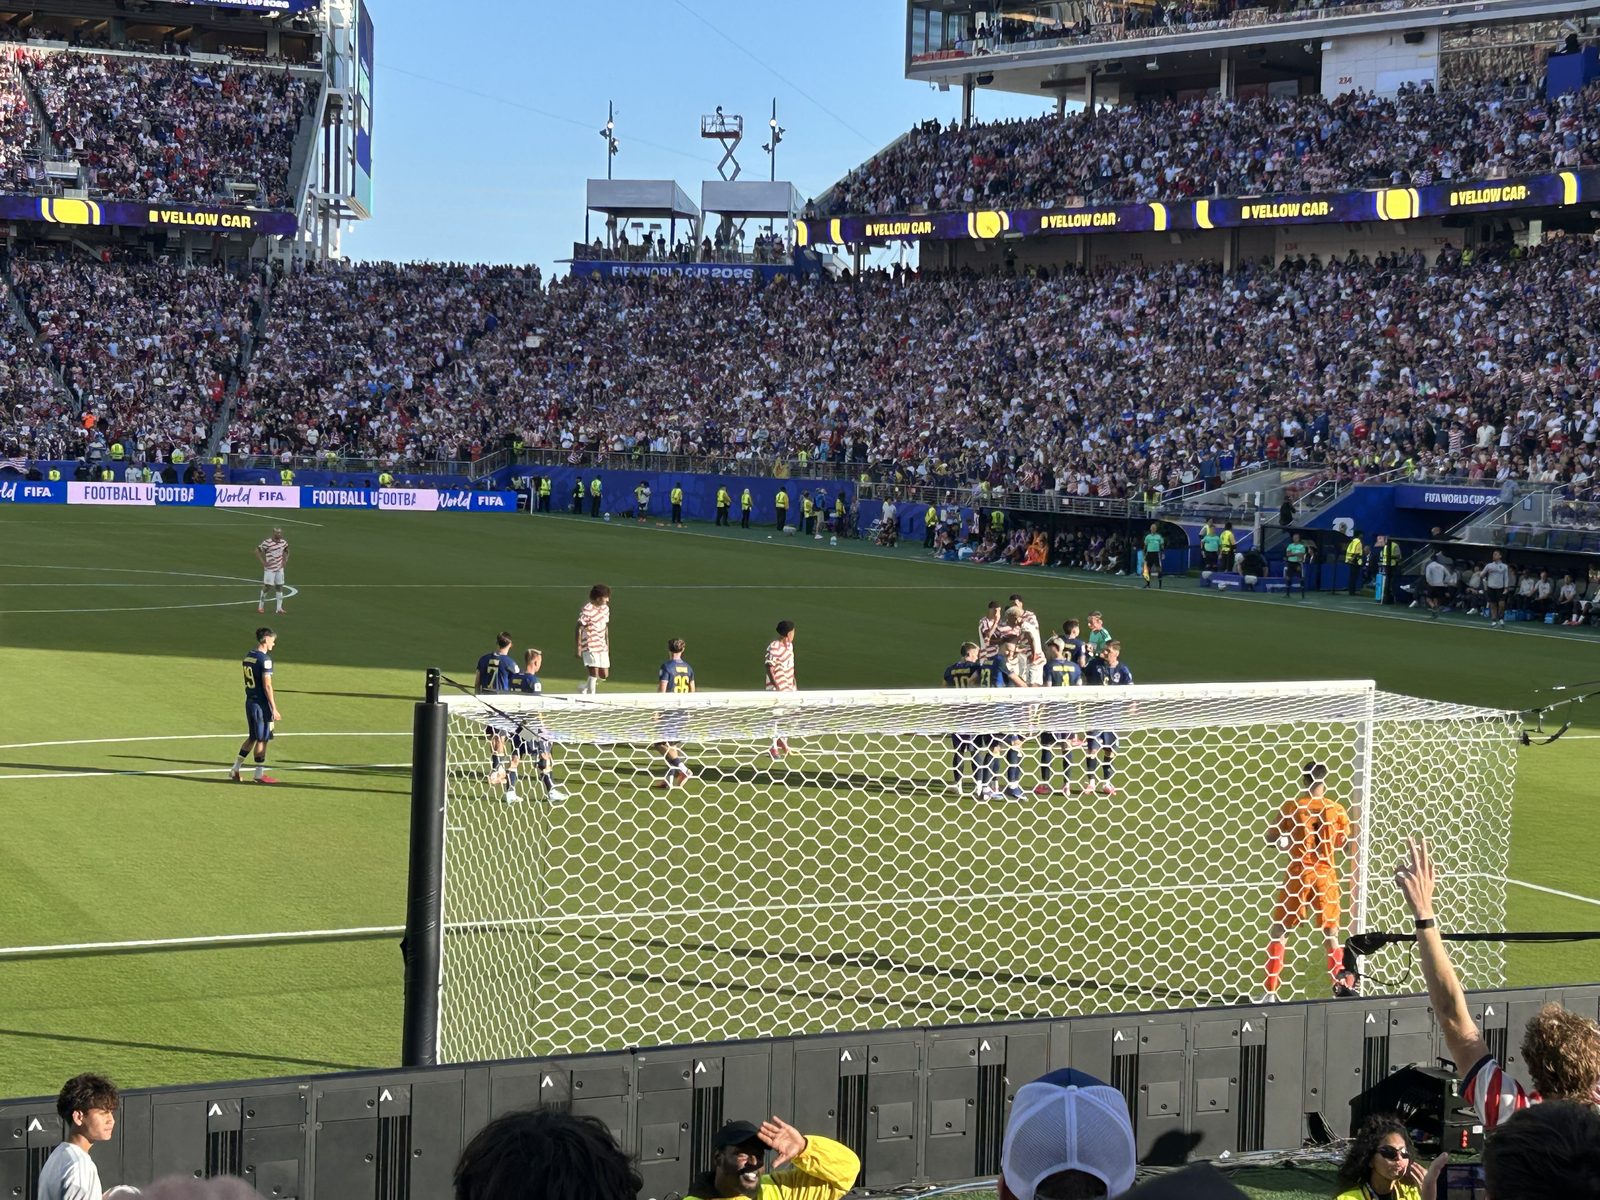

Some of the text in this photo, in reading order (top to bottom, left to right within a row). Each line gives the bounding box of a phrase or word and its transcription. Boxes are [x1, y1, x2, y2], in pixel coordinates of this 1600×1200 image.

[1458, 185, 1526, 205] YELLOW CAR
[161, 210, 251, 228] YELLOW CAR
[1251, 201, 1328, 219] YELLOW CAR
[872, 221, 932, 236] YELLOW CAR
[1049, 212, 1116, 228] YELLOW CAR
[711, 267, 754, 279] 2026
[0, 481, 52, 502] ld FIFA
[84, 486, 141, 501] FOOTBALL
[216, 487, 284, 505] World FIFA
[313, 490, 367, 505] FOOTBALL
[439, 491, 504, 510] World FIFA
[1424, 492, 1440, 503] FIFA
[1441, 493, 1469, 504] WORLD
[1469, 495, 1485, 505] CUP
[487, 666, 500, 688] 7
